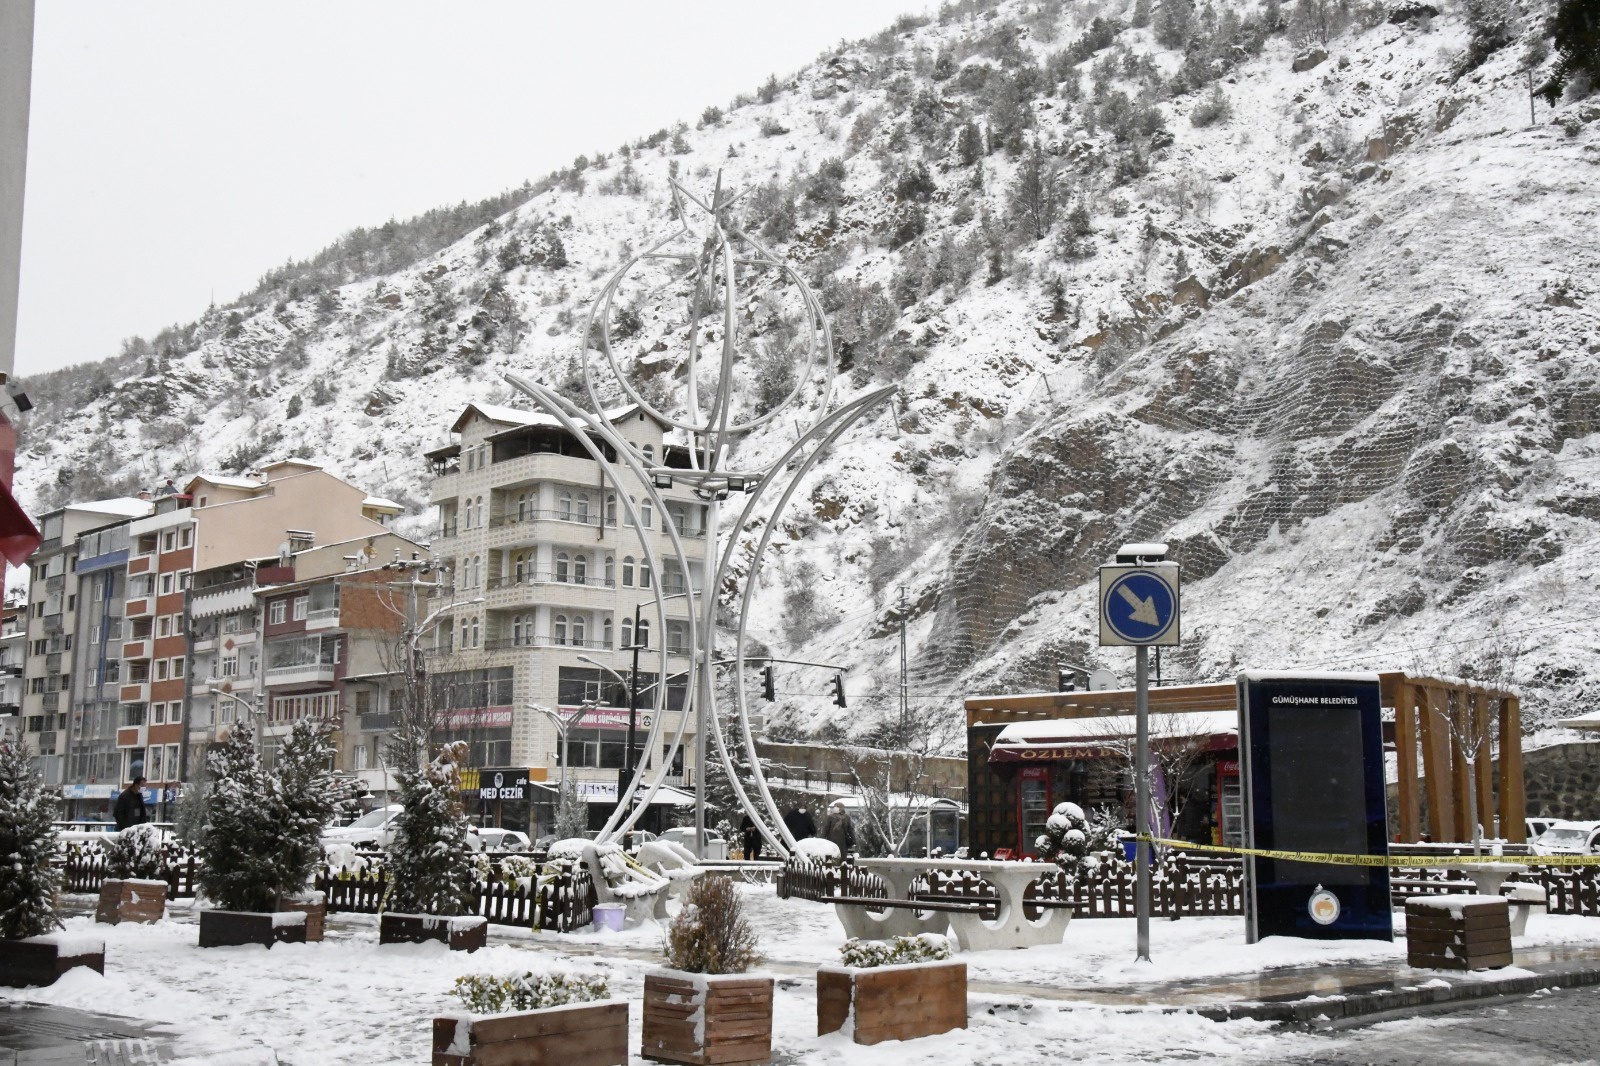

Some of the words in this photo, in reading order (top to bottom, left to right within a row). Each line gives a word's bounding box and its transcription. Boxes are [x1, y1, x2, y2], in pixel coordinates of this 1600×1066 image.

[1272, 695, 1319, 706] GÜMÜŞHANE
[1320, 695, 1358, 705] BELEDİYESİ
[1020, 748, 1094, 759] ÖZLEM
[516, 777, 527, 785] cafe
[480, 787, 498, 799] MED
[499, 784, 523, 799] CEZİR
